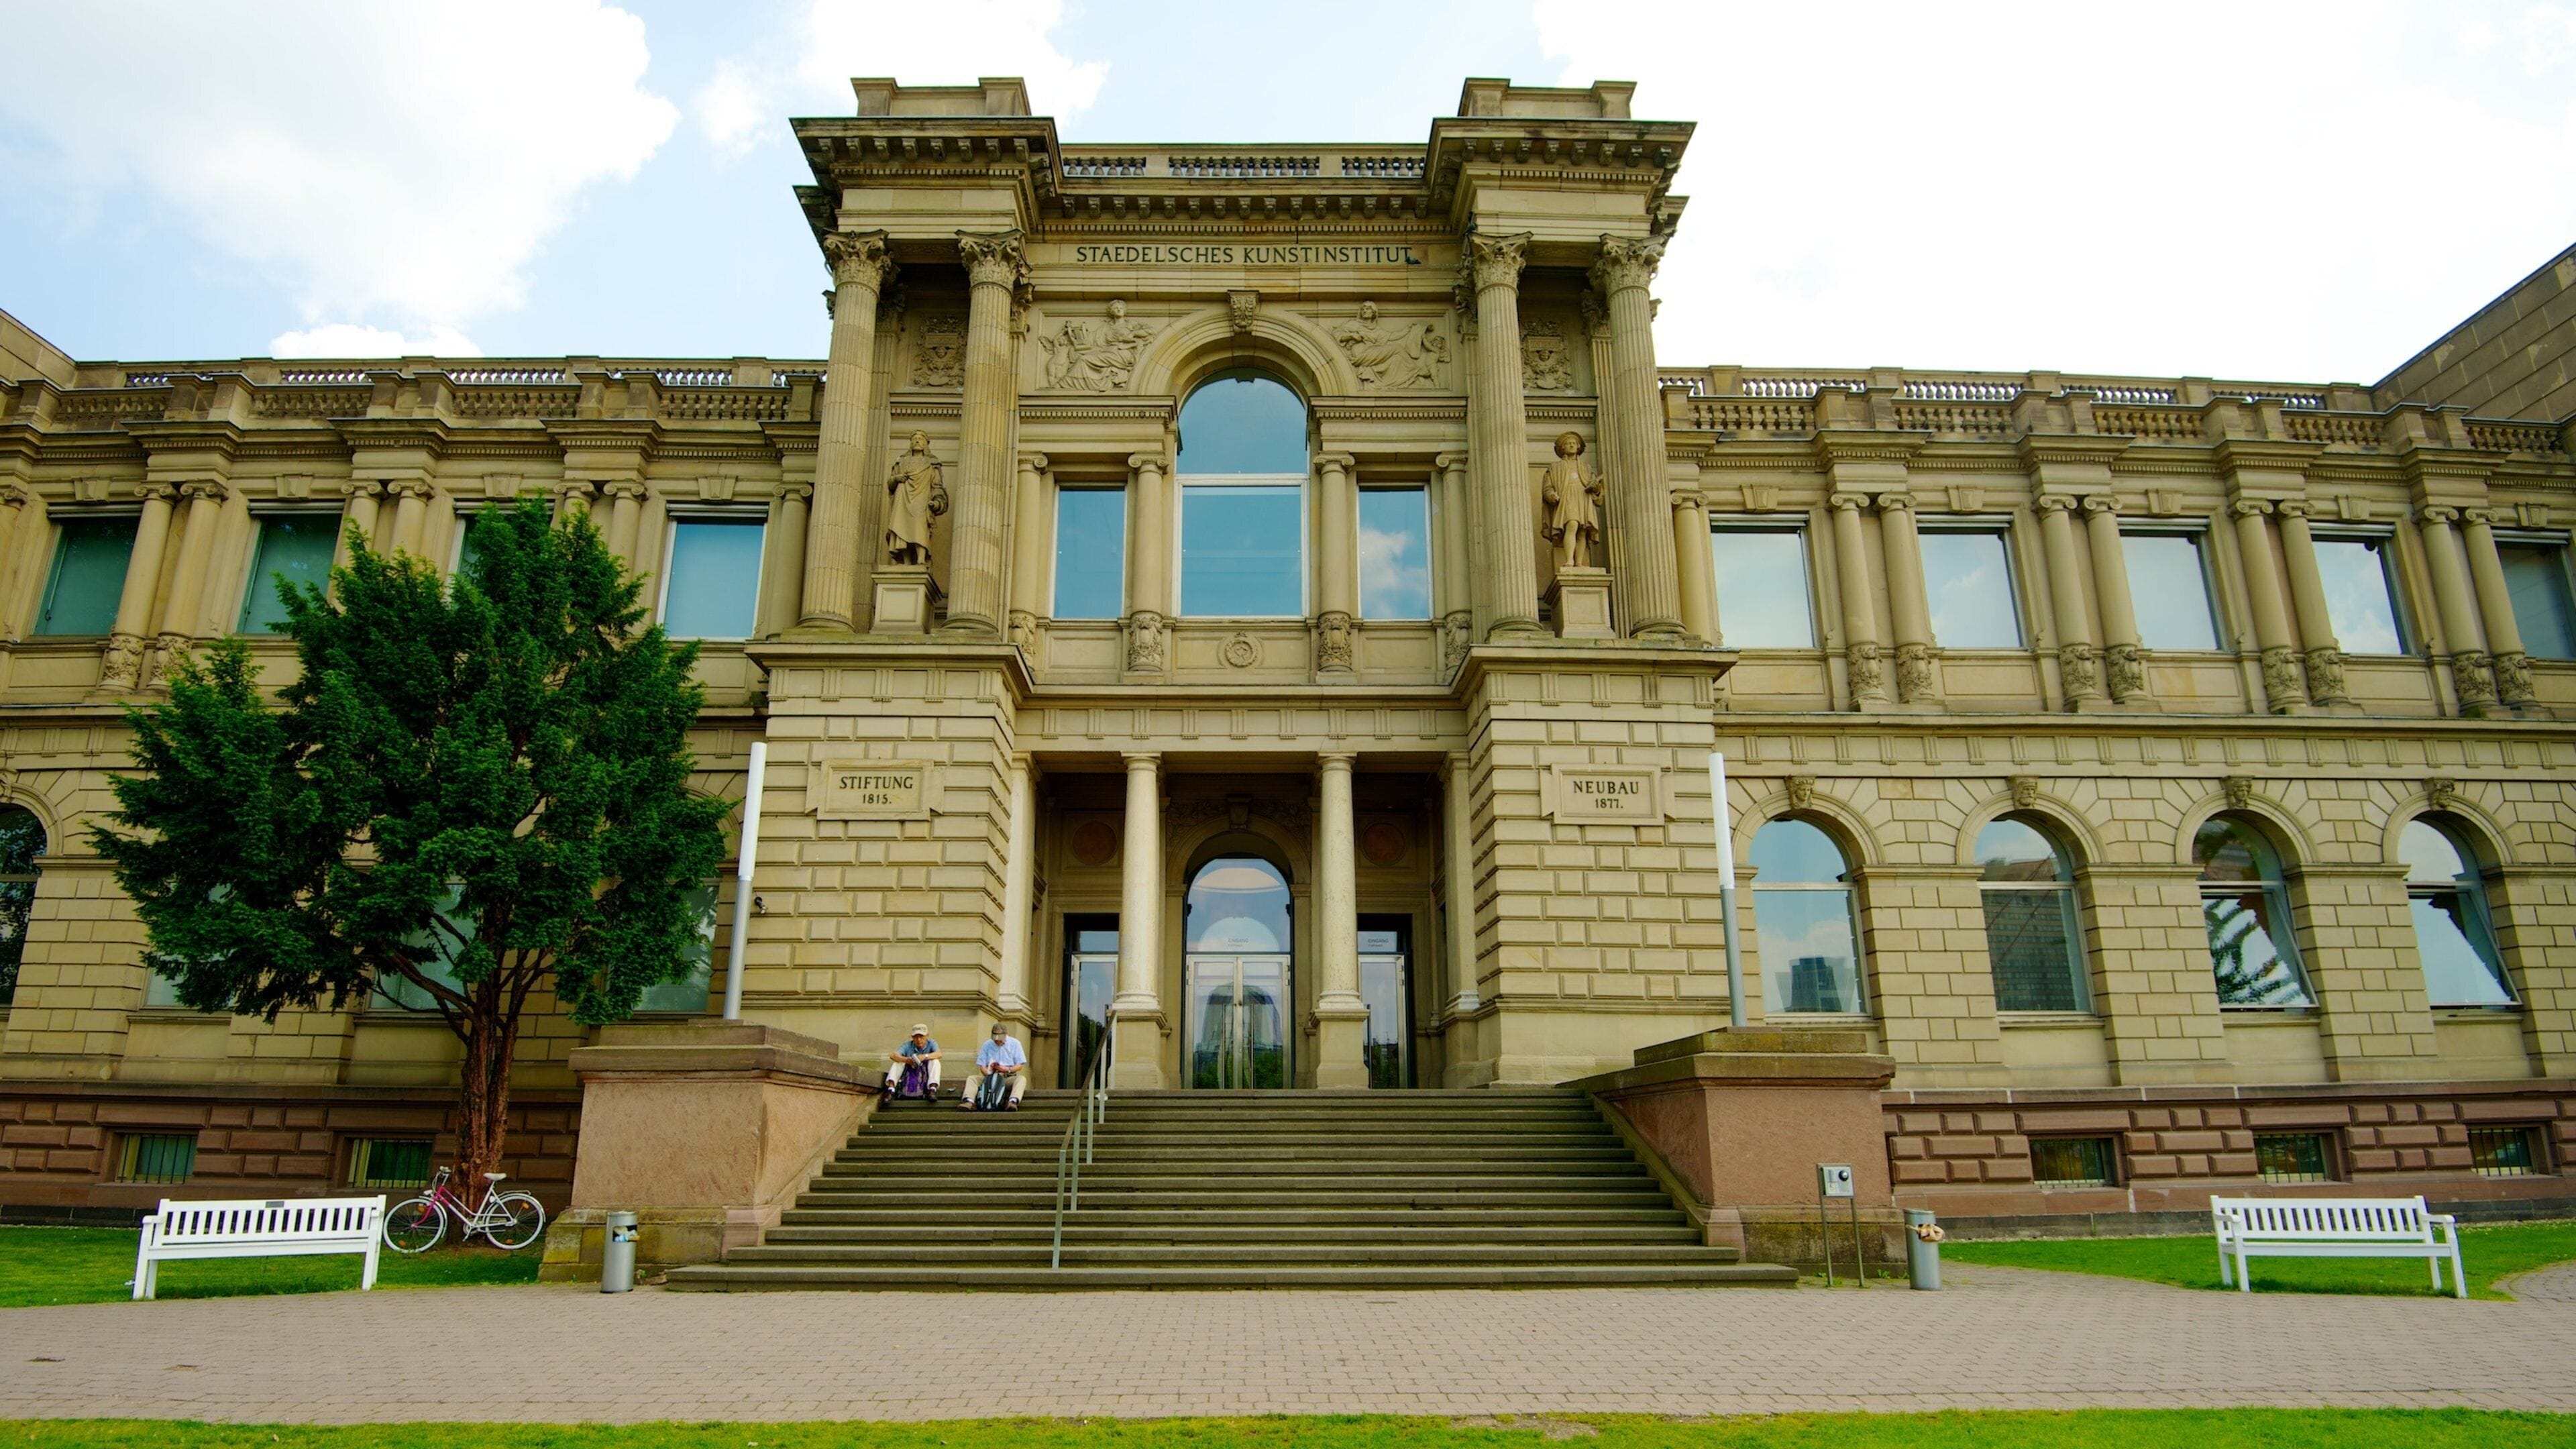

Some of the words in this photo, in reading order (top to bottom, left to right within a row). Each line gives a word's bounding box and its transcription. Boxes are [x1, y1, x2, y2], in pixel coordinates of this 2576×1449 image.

[1077, 246, 1234, 263] STAEDELSCHES
[1243, 246, 1412, 264] KUNSTINSTITUT
[839, 776, 914, 790] STIFTUNG
[1572, 780, 1640, 794] NEUBAU
[862, 794, 892, 804] 1815.
[1595, 798, 1623, 809] 1877.
